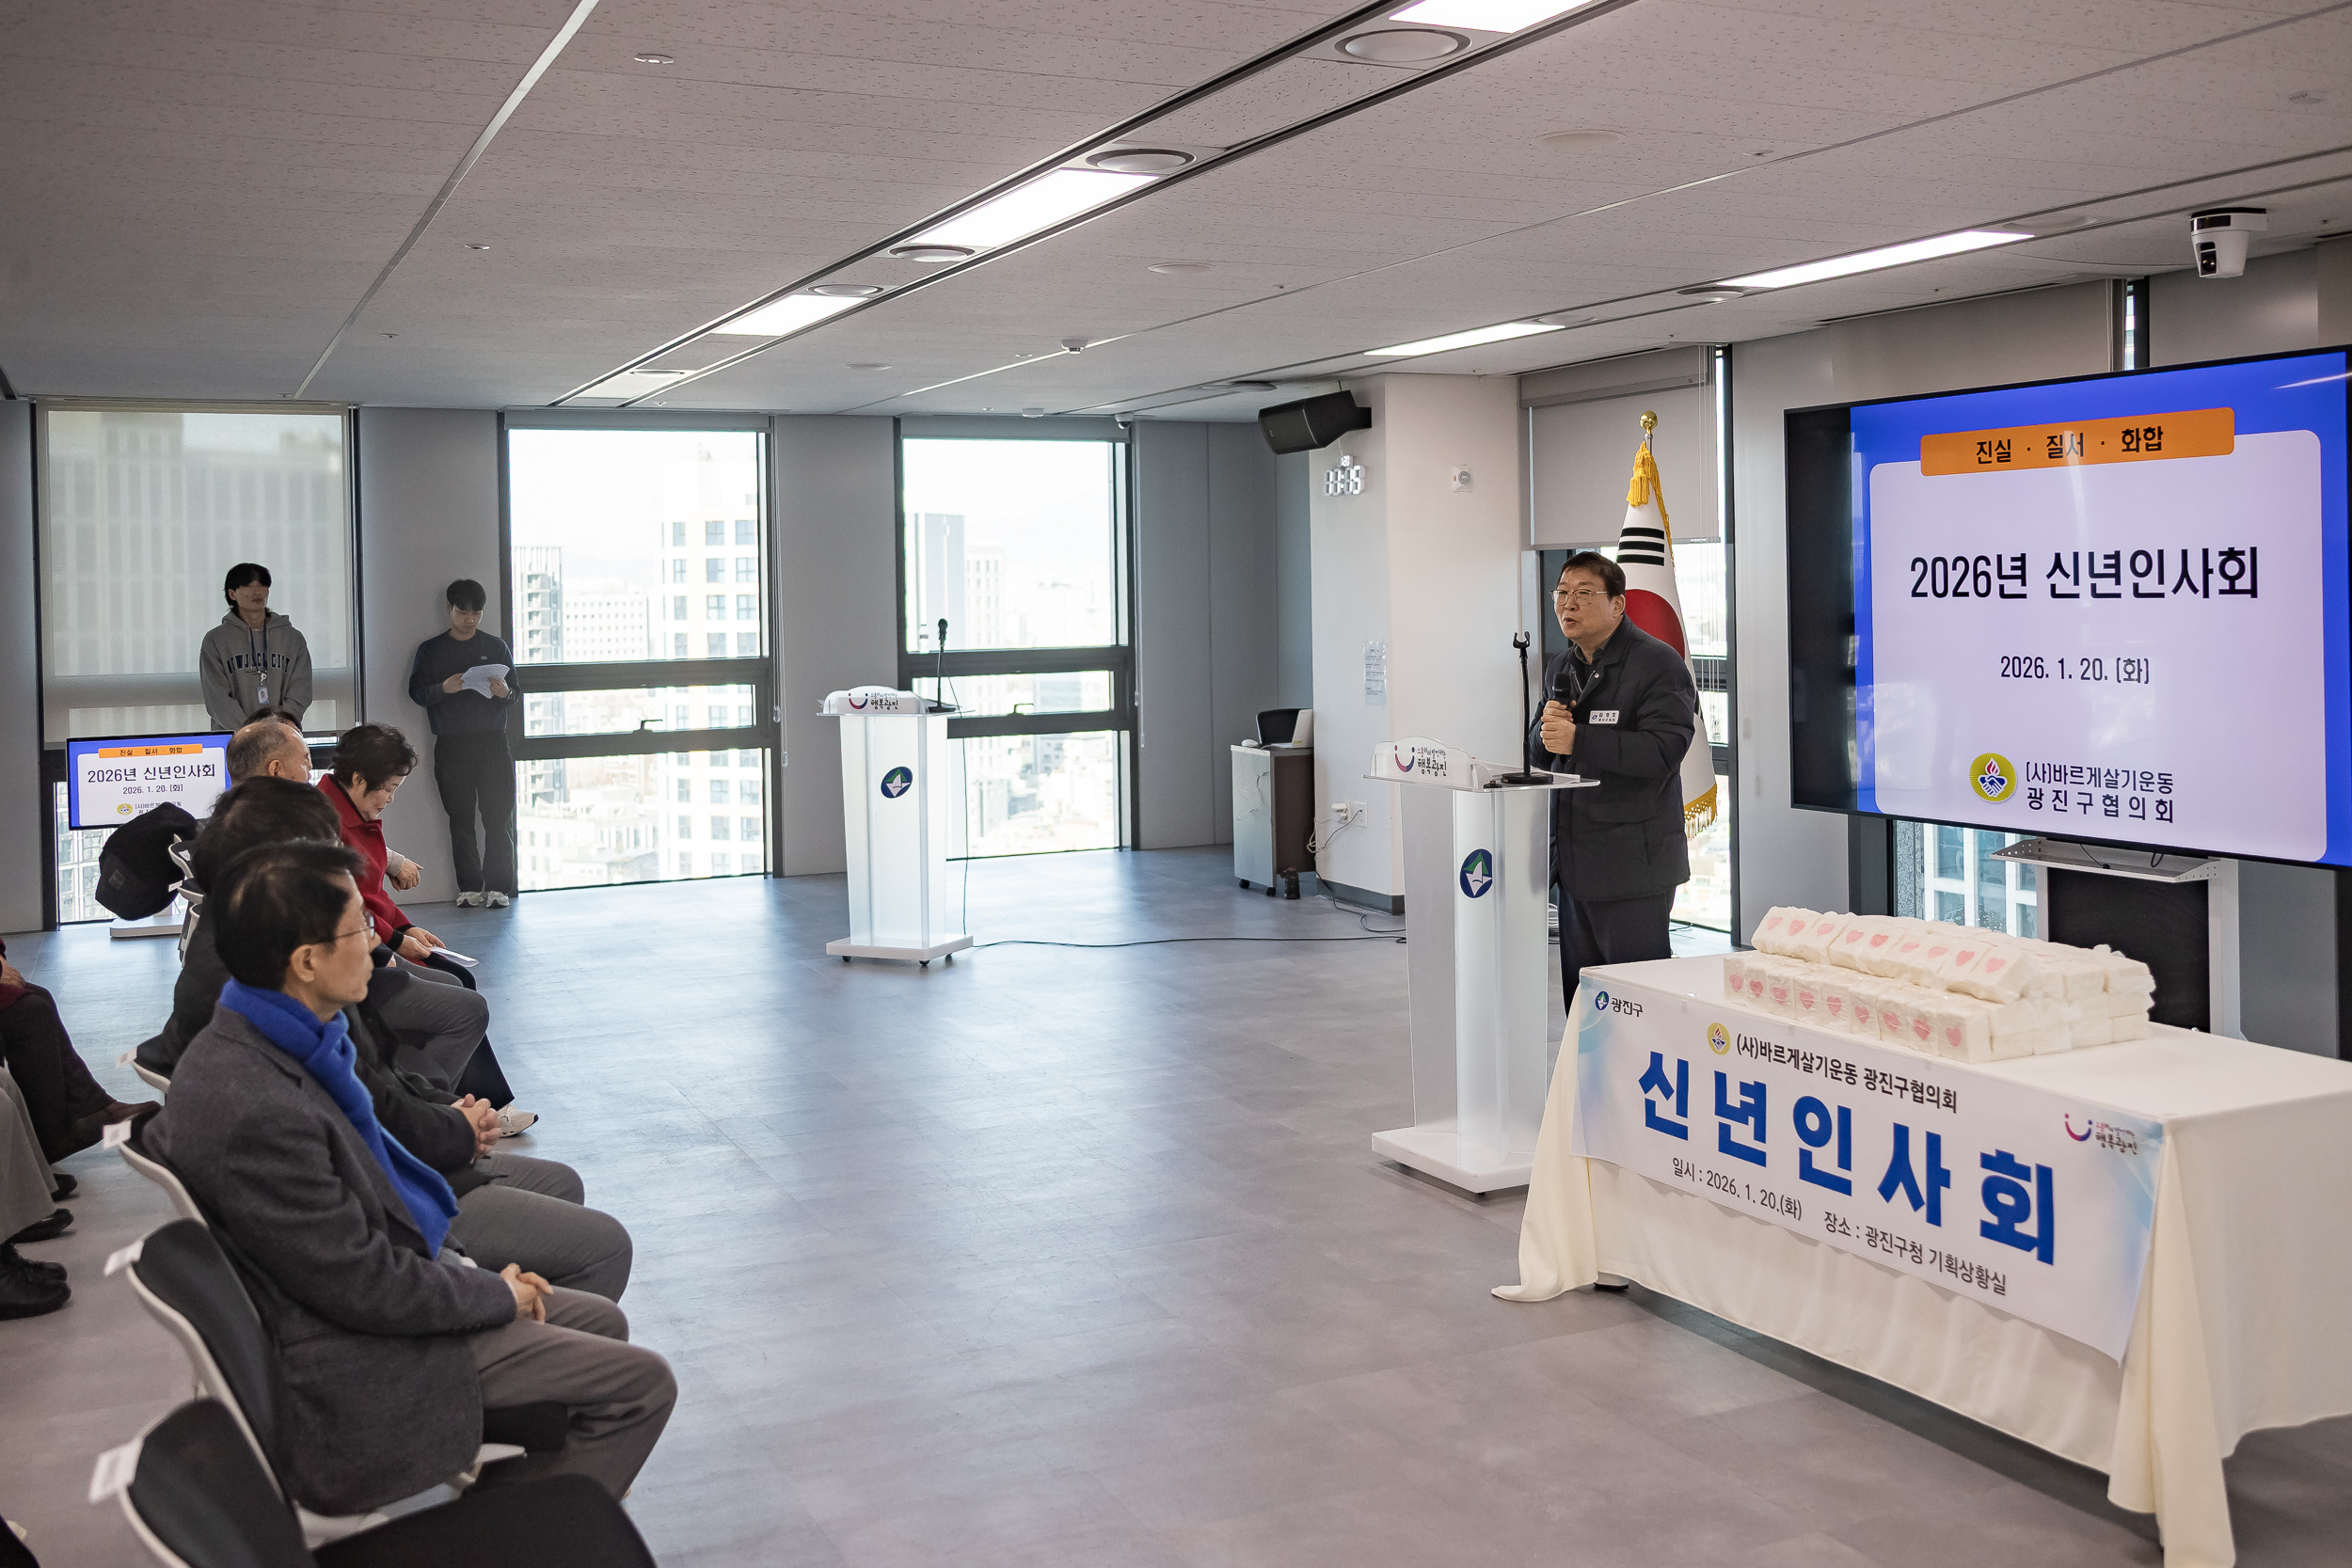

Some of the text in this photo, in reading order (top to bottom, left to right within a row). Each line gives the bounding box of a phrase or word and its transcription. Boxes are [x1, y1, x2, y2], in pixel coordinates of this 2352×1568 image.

[1976, 439, 2011, 465] 진실
[2046, 432, 2085, 459] 질서
[2121, 425, 2164, 452] 화합
[1910, 546, 2260, 600] 2026년 신년인사회
[2000, 656, 2049, 679] 2026.
[2058, 657, 2073, 680] 1.
[2080, 657, 2108, 681] 20.
[87, 763, 215, 783] 2026년 신년인사회
[1418, 757, 1447, 777] 행복광진
[2026, 761, 2174, 795] (사)바르게살기운동
[122, 785, 144, 795] 2026.
[155, 784, 167, 793] 20.
[1610, 997, 1644, 1018] 광진구
[1737, 1033, 1957, 1114] (사)바르게살기운동 광진구협의회
[1638, 1051, 2054, 1266] 신년인사회
[1672, 1157, 1694, 1182] 일시
[1706, 1169, 1740, 1198] 2026.
[1744, 1183, 1756, 1204] 1.
[1823, 1211, 1851, 1237] 장소
[1865, 1225, 1923, 1265] 광진구청
[1928, 1248, 2007, 1296] 기획상황실
